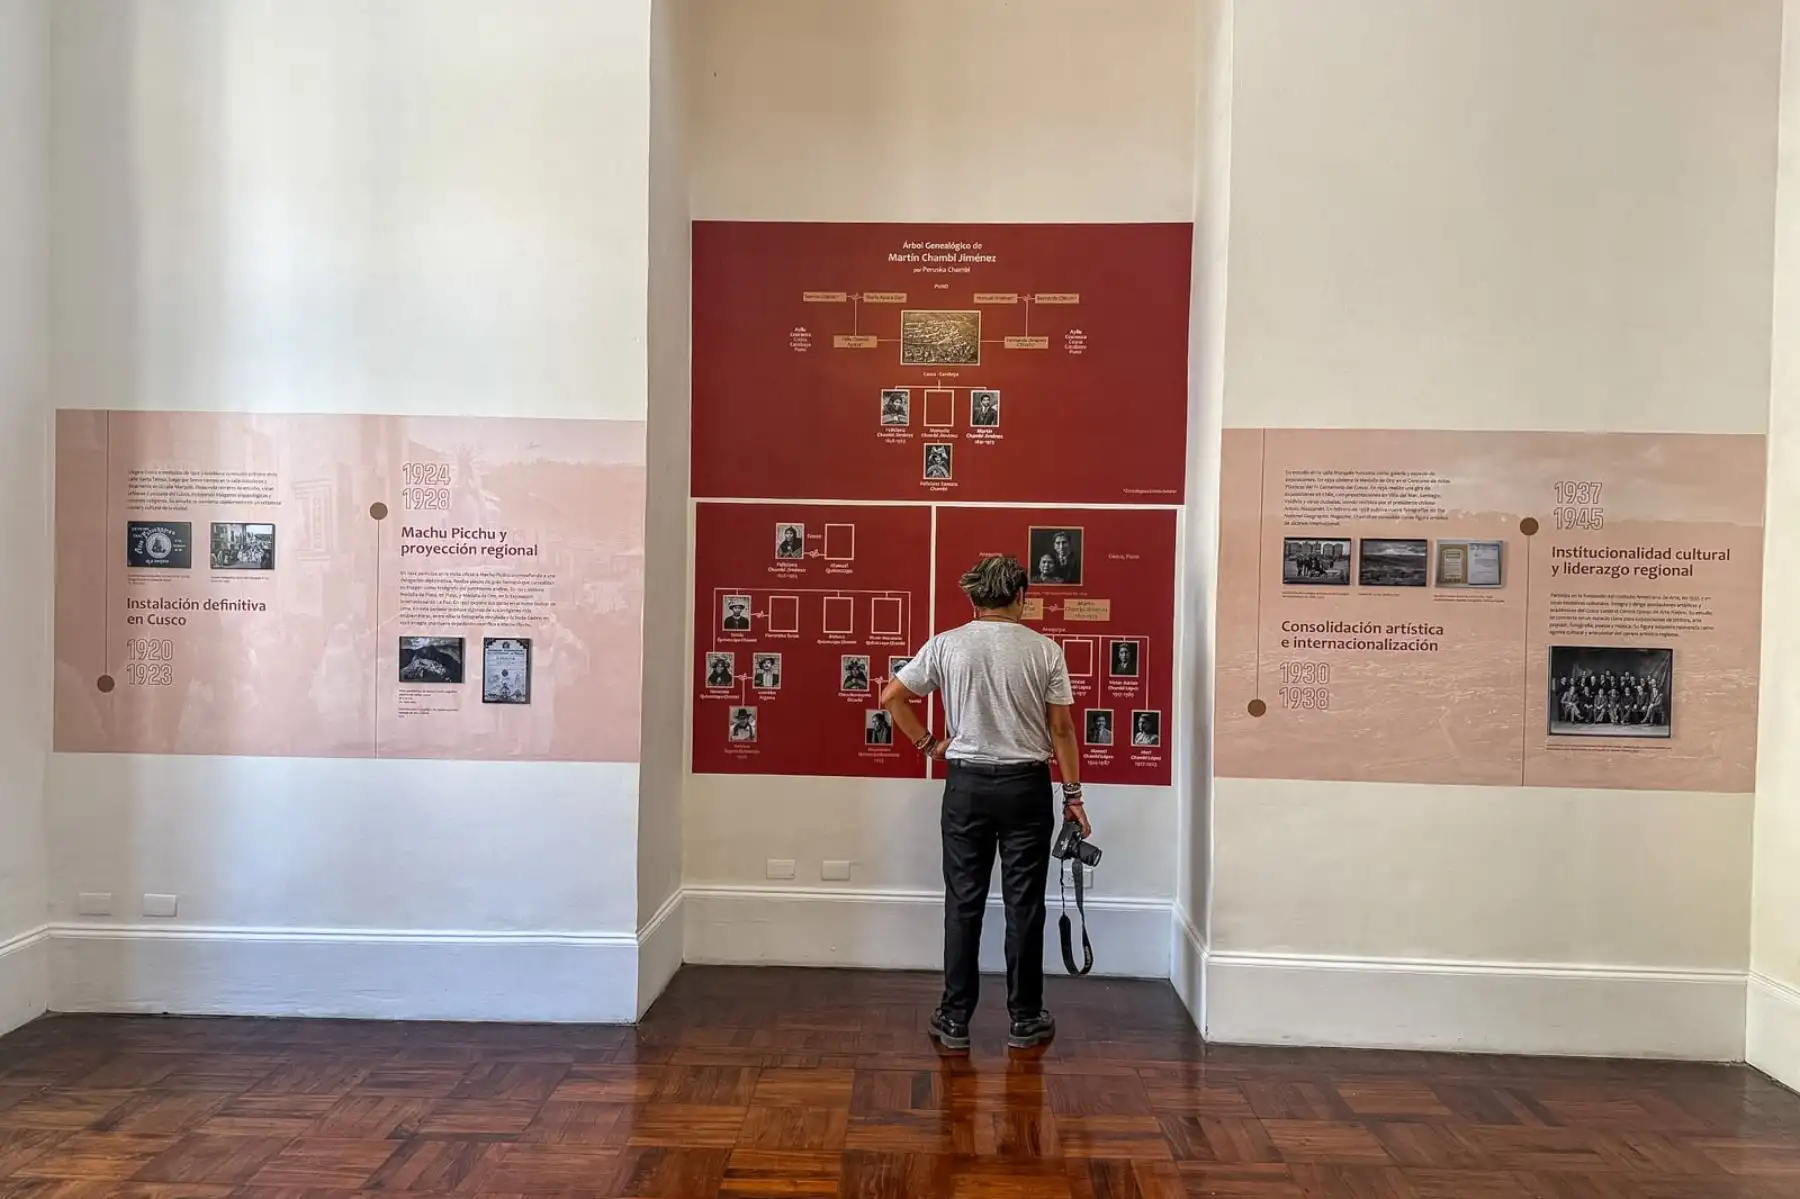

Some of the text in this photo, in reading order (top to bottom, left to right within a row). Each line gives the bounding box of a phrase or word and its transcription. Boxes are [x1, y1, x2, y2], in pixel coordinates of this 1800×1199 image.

[903, 240, 983, 252] Árbol Genealógico de
[921, 253, 957, 262] Chambi
[958, 253, 997, 263] Jiménez
[402, 463, 451, 486] 1924
[402, 487, 450, 511] 1928
[1554, 480, 1603, 505] 1937
[1553, 506, 1604, 531] 1945
[401, 526, 508, 543] Machu Picchu y
[400, 542, 538, 560] proyección regional
[1551, 545, 1731, 562] Institucionalidad cultural
[1551, 562, 1694, 580] y liderazgo regional
[127, 597, 267, 612] Instalación definitiva
[127, 614, 187, 626] en Cusco
[1281, 620, 1444, 636] Consolidación artística
[126, 638, 173, 661] 1920
[1281, 636, 1439, 652] e internacionalización
[126, 663, 173, 686] 1923
[1279, 661, 1331, 685] 1930
[1279, 686, 1330, 710] 1938
